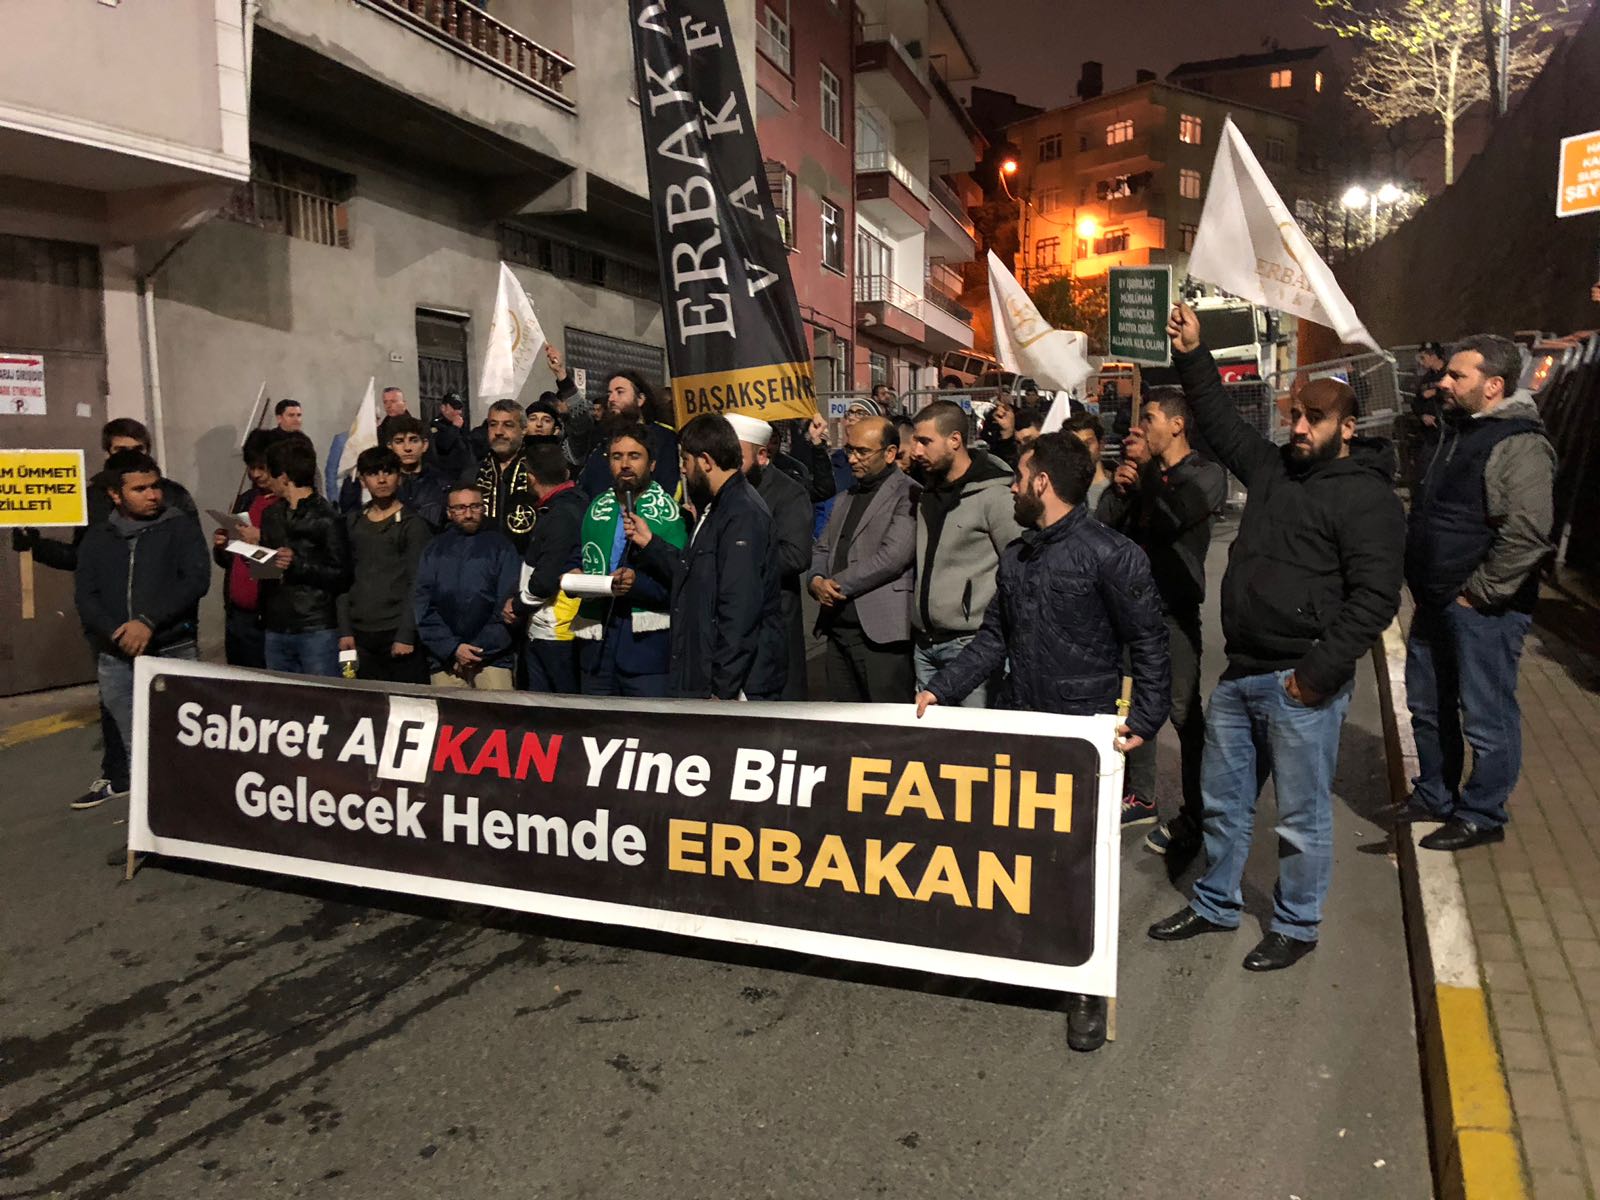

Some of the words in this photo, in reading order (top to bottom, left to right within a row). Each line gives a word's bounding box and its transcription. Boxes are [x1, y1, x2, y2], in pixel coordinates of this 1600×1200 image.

[684, 371, 816, 414] BAŞAKŞEHİR
[17, 465, 77, 478] ÜMMETİ
[25, 483, 77, 495] ETMEZ
[0, 498, 52, 511] ZİLLETİ
[175, 702, 329, 760] Sabret
[581, 735, 711, 797] Yine
[729, 747, 827, 808] Bir
[847, 753, 1073, 833] FATİH
[235, 771, 426, 839] Gelecek
[442, 793, 647, 867] Hemde
[668, 818, 1032, 915] ERBAKAN
